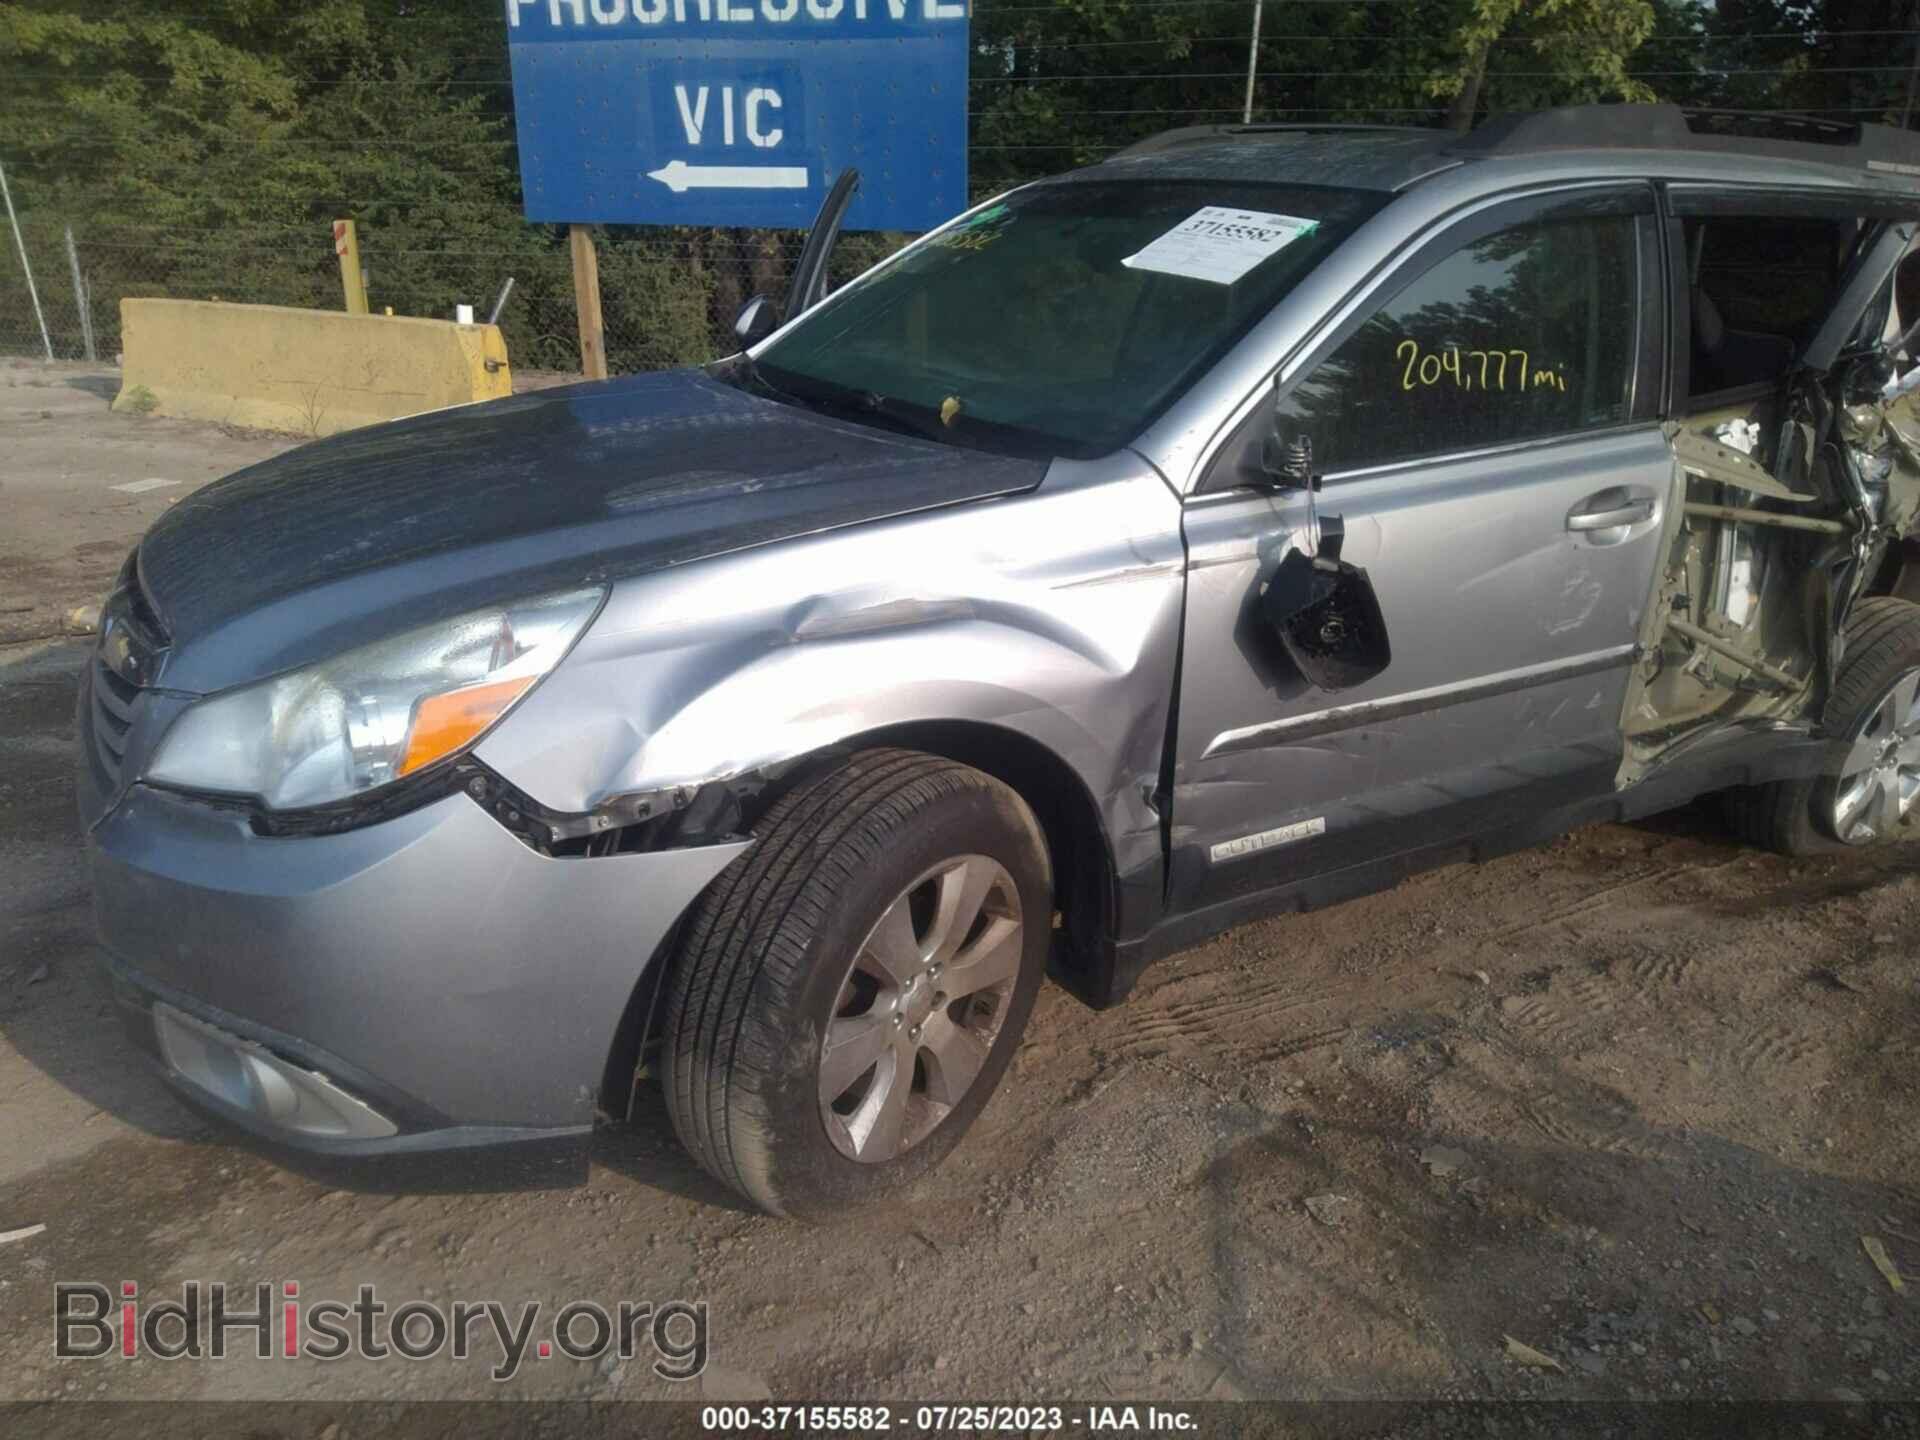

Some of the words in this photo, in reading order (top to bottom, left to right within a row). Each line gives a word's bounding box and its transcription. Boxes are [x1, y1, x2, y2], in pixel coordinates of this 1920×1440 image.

[674, 85, 783, 148] VIC
[1184, 219, 1282, 242] 37155582
[1396, 339, 1528, 392] 204,777
[1533, 362, 1566, 392] mi
